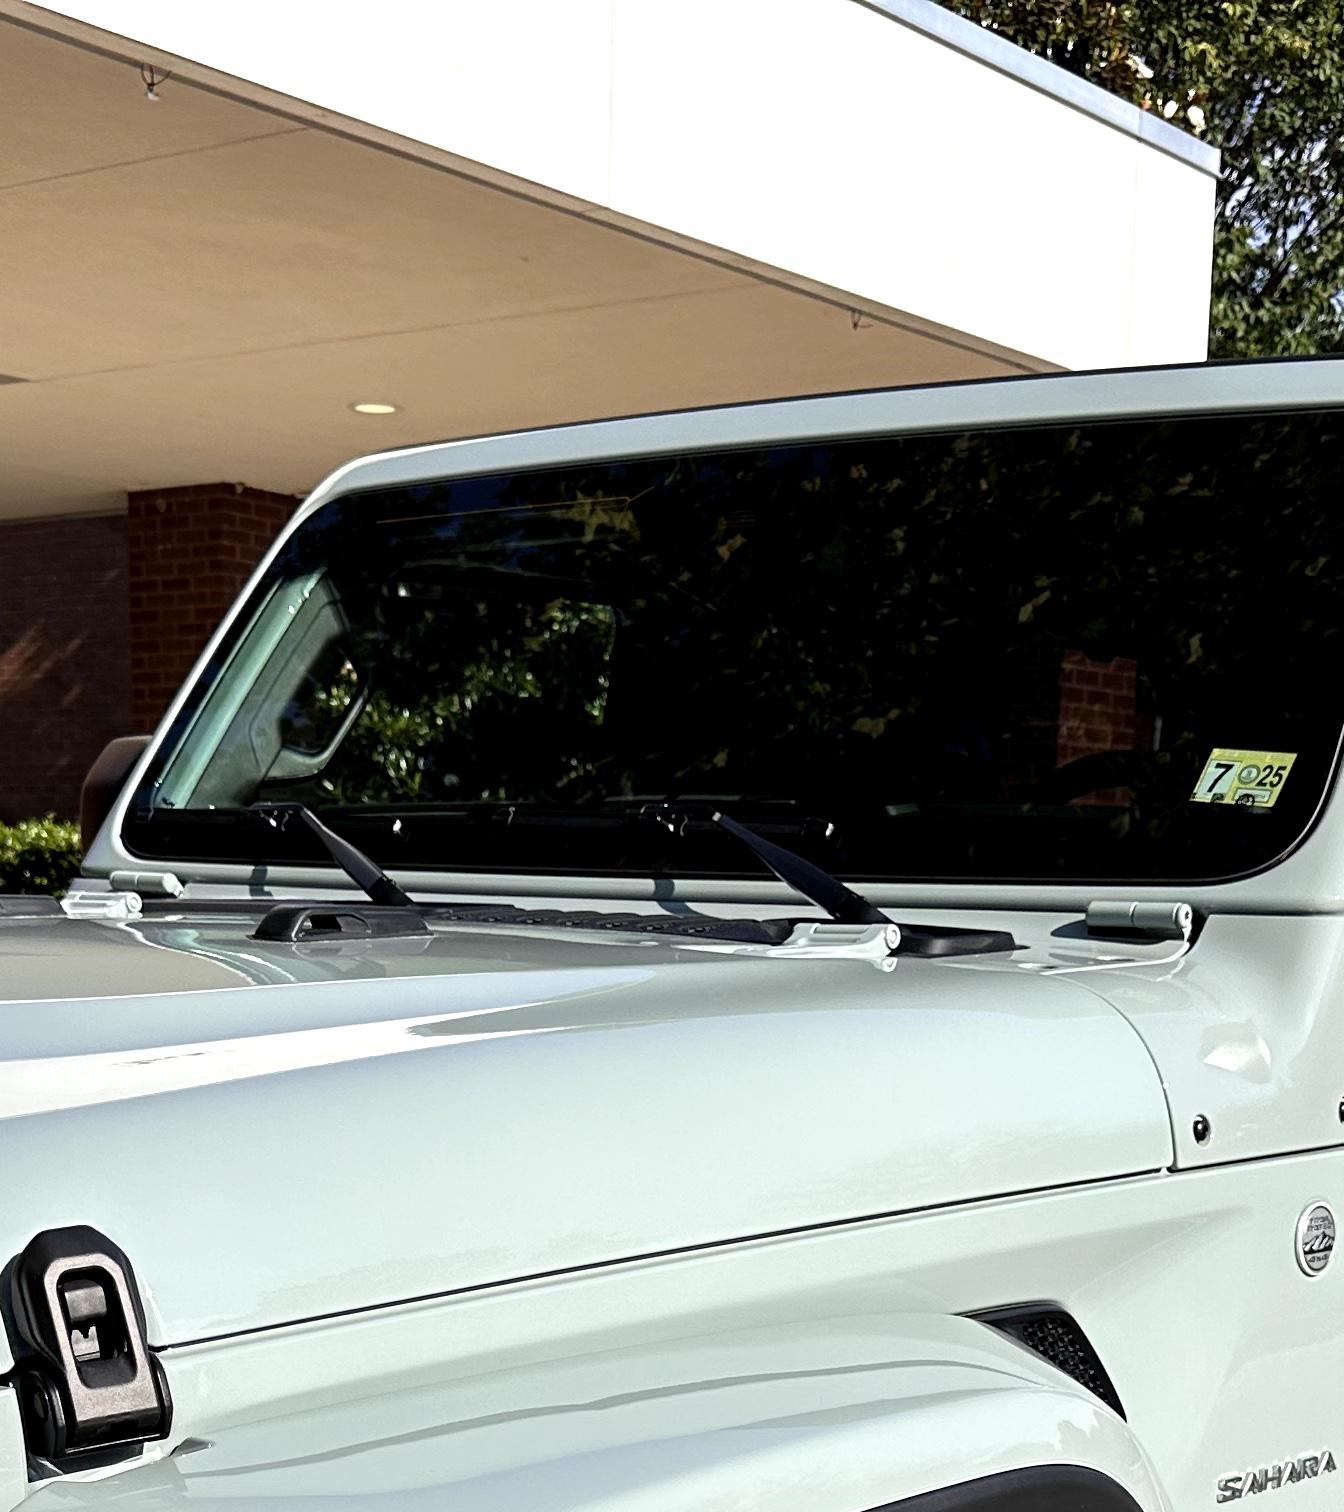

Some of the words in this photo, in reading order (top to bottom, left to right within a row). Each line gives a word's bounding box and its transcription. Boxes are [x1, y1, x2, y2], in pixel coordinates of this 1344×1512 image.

[1206, 762, 1235, 793] 7
[1255, 764, 1287, 788] 25
[1216, 1450, 1337, 1503] SAHARA
